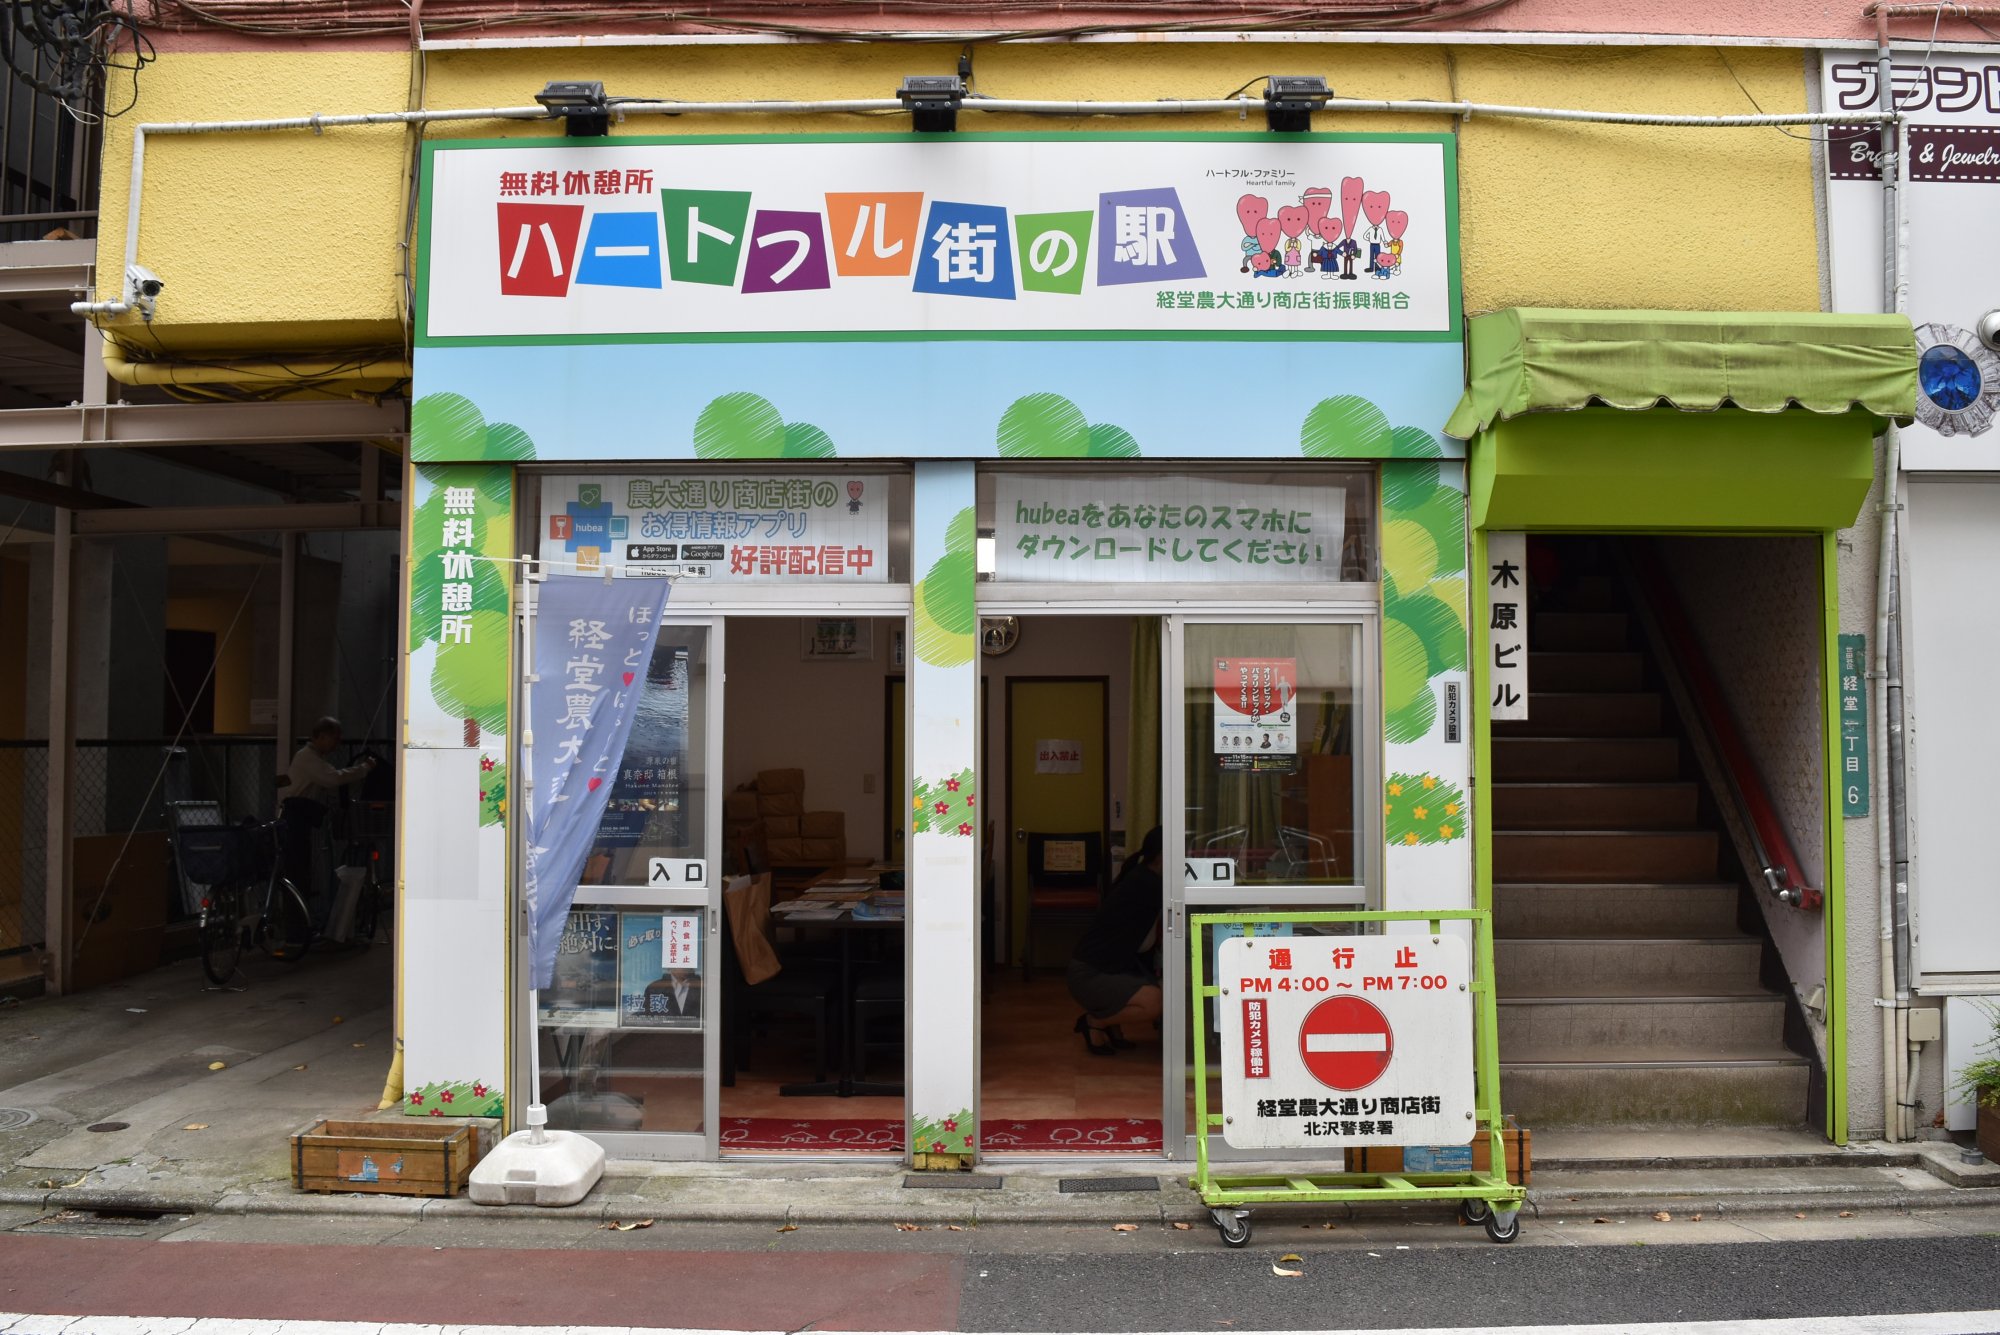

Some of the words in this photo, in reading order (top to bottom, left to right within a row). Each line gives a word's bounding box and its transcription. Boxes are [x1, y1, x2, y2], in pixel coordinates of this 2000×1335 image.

[1919, 142, 1934, 163] &
[499, 168, 654, 197] 無料休憩所
[1156, 290, 1410, 311] 経堂農大通り商店街振興組合
[626, 478, 839, 509] 農大通り商店街の
[575, 522, 603, 533] hubea
[641, 511, 807, 540] お得情報アプリ
[1015, 501, 1312, 534] hubeaをあなたのスマホに
[690, 551, 711, 560] Google
[730, 544, 873, 576] 好評配信中
[1015, 535, 1323, 565] ダウンロードしてください
[440, 486, 476, 644] 無料休憩所
[1490, 559, 1522, 707] 木原ビル
[1040, 750, 1080, 761] 出入禁止
[1848, 785, 1859, 804] 6
[652, 863, 703, 882] 入口
[682, 920, 691, 964] 飲食禁止
[1240, 976, 1272, 993] PM
[1277, 976, 1329, 992] 4:00
[1362, 975, 1393, 991] PM
[1398, 974, 1448, 990] 7:00
[1248, 1001, 1264, 1076] 防犯カメラ稼働中
[1257, 1095, 1441, 1118] 経堂農大通り商店街
[1303, 1120, 1394, 1136] 北沢警察署
